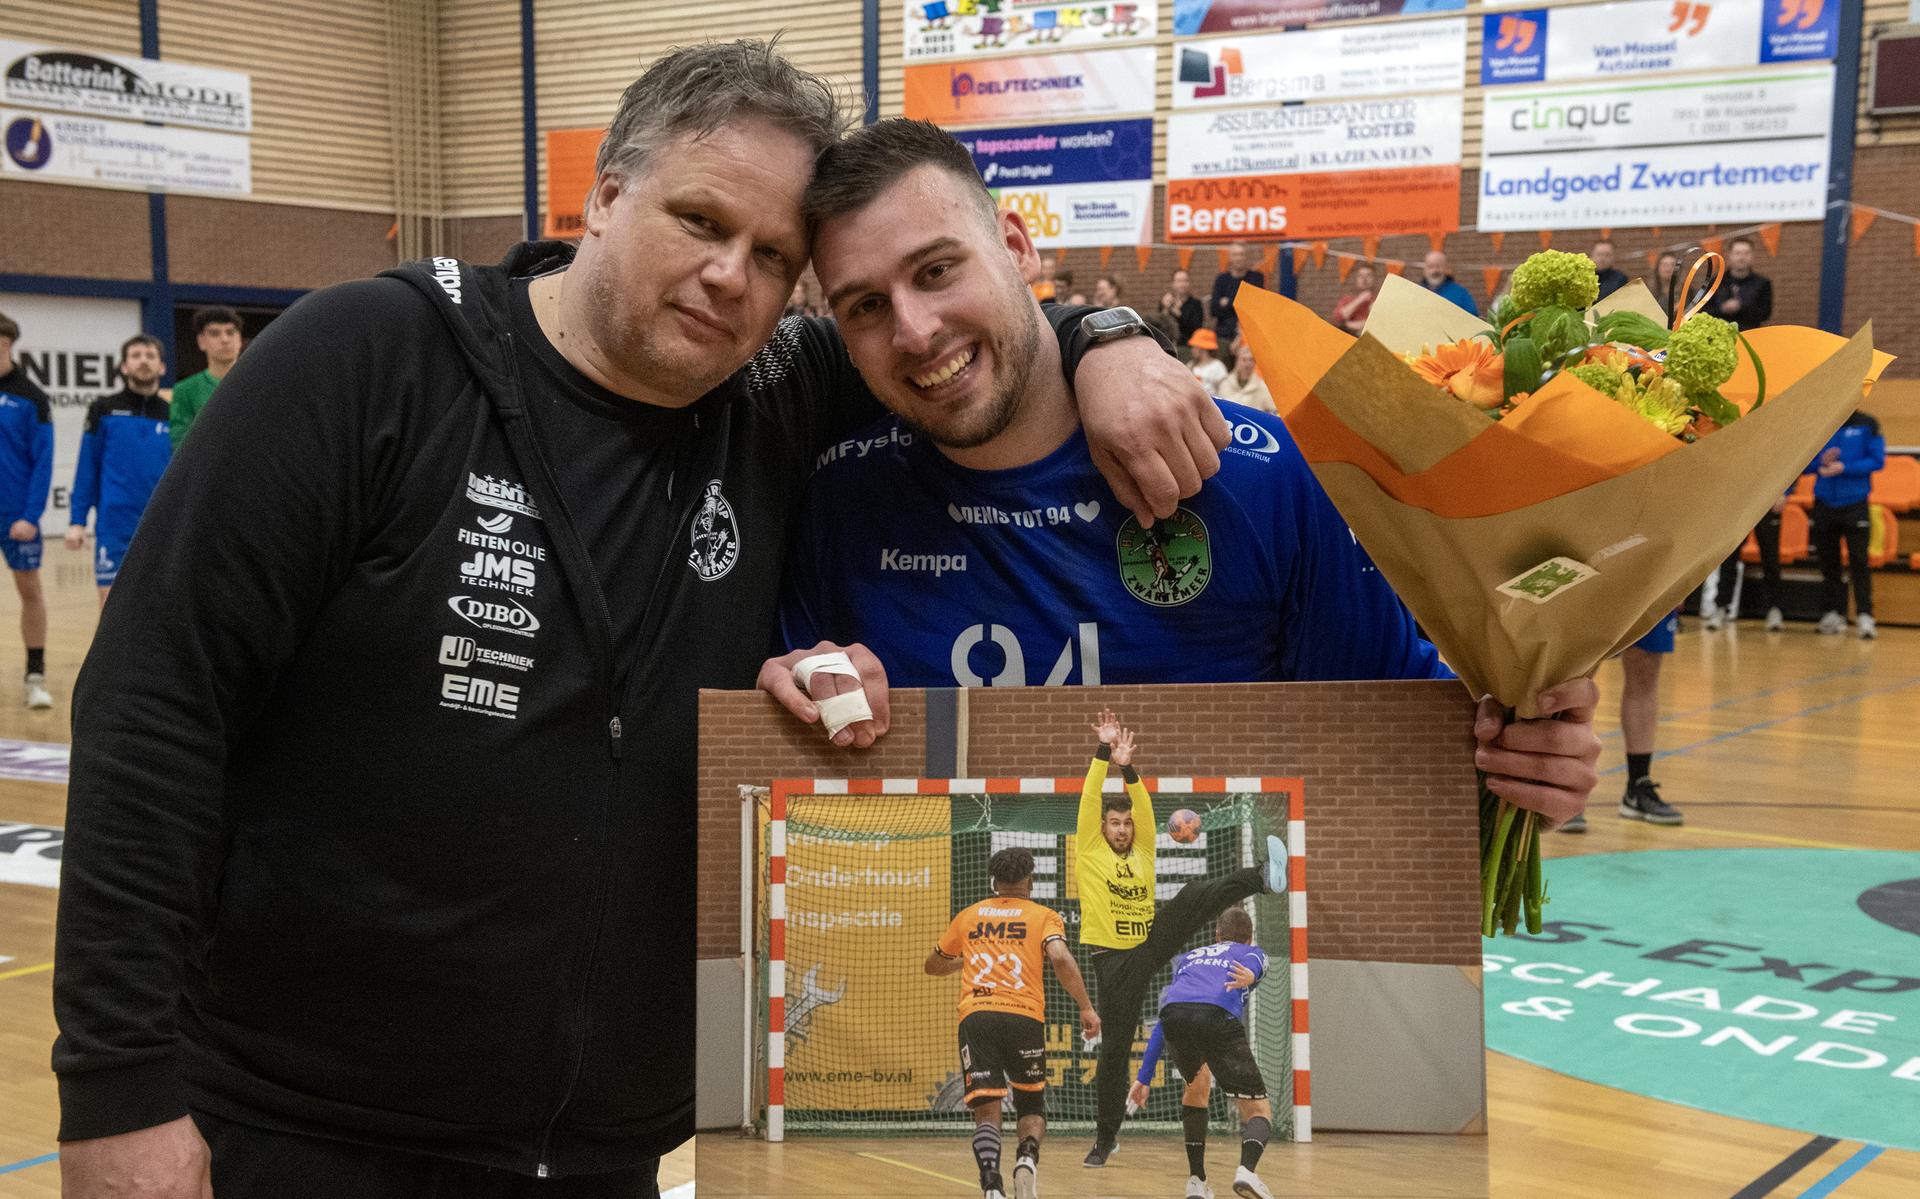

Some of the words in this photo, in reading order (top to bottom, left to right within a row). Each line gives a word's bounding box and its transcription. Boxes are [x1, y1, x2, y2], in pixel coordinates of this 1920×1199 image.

[976, 74, 1084, 95] DELFTECHNIEK
[1229, 72, 1327, 99] Bergsma
[1347, 121, 1417, 141] KOSTER
[1483, 164, 1622, 202] Landgoed
[1630, 160, 1822, 191] Zwartemeer
[1168, 203, 1288, 234] Berens
[960, 505, 1011, 525] DENIS
[1011, 509, 1043, 529] TOT
[1046, 506, 1071, 526] 94
[457, 527, 511, 552] FIETEN
[511, 541, 546, 561] OLIE
[460, 551, 536, 588] JMS
[880, 548, 967, 577] Kempa
[460, 575, 535, 597] TECHNIEK
[1127, 567, 1208, 603] ZWARTEMEER
[466, 599, 527, 627] DIBO
[476, 647, 535, 669] TECHNIEK
[440, 673, 520, 712] EME
[786, 865, 931, 888] Onderhoud
[968, 921, 1028, 940] JMS
[969, 951, 1026, 990] 23
[1482, 953, 1897, 1035] SCHADE
[1501, 996, 1575, 1023] &
[783, 1068, 913, 1085] www.eme-bv.nl
